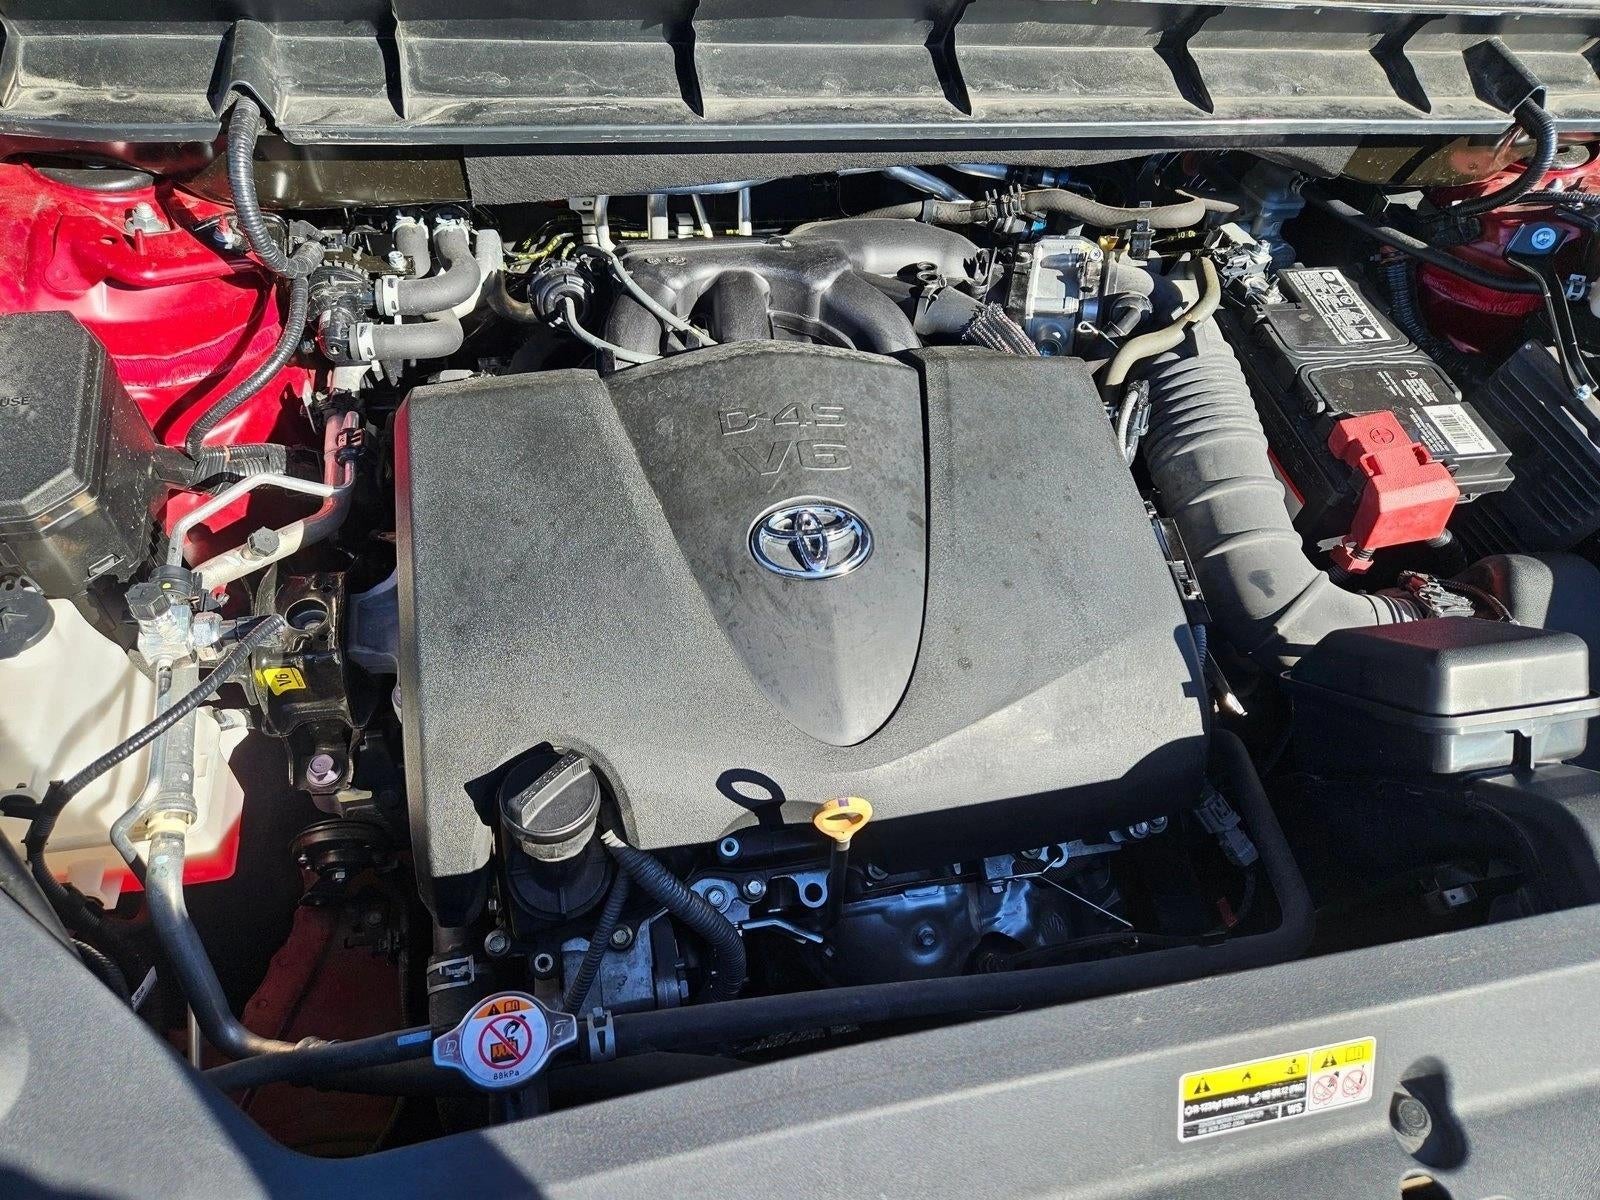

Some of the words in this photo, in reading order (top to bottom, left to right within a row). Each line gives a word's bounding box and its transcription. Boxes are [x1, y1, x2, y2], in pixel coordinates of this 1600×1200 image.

[718, 402, 848, 436] D-4S
[733, 438, 852, 475] V6
[274, 673, 292, 687] V6
[493, 1070, 520, 1081] 88kPa
